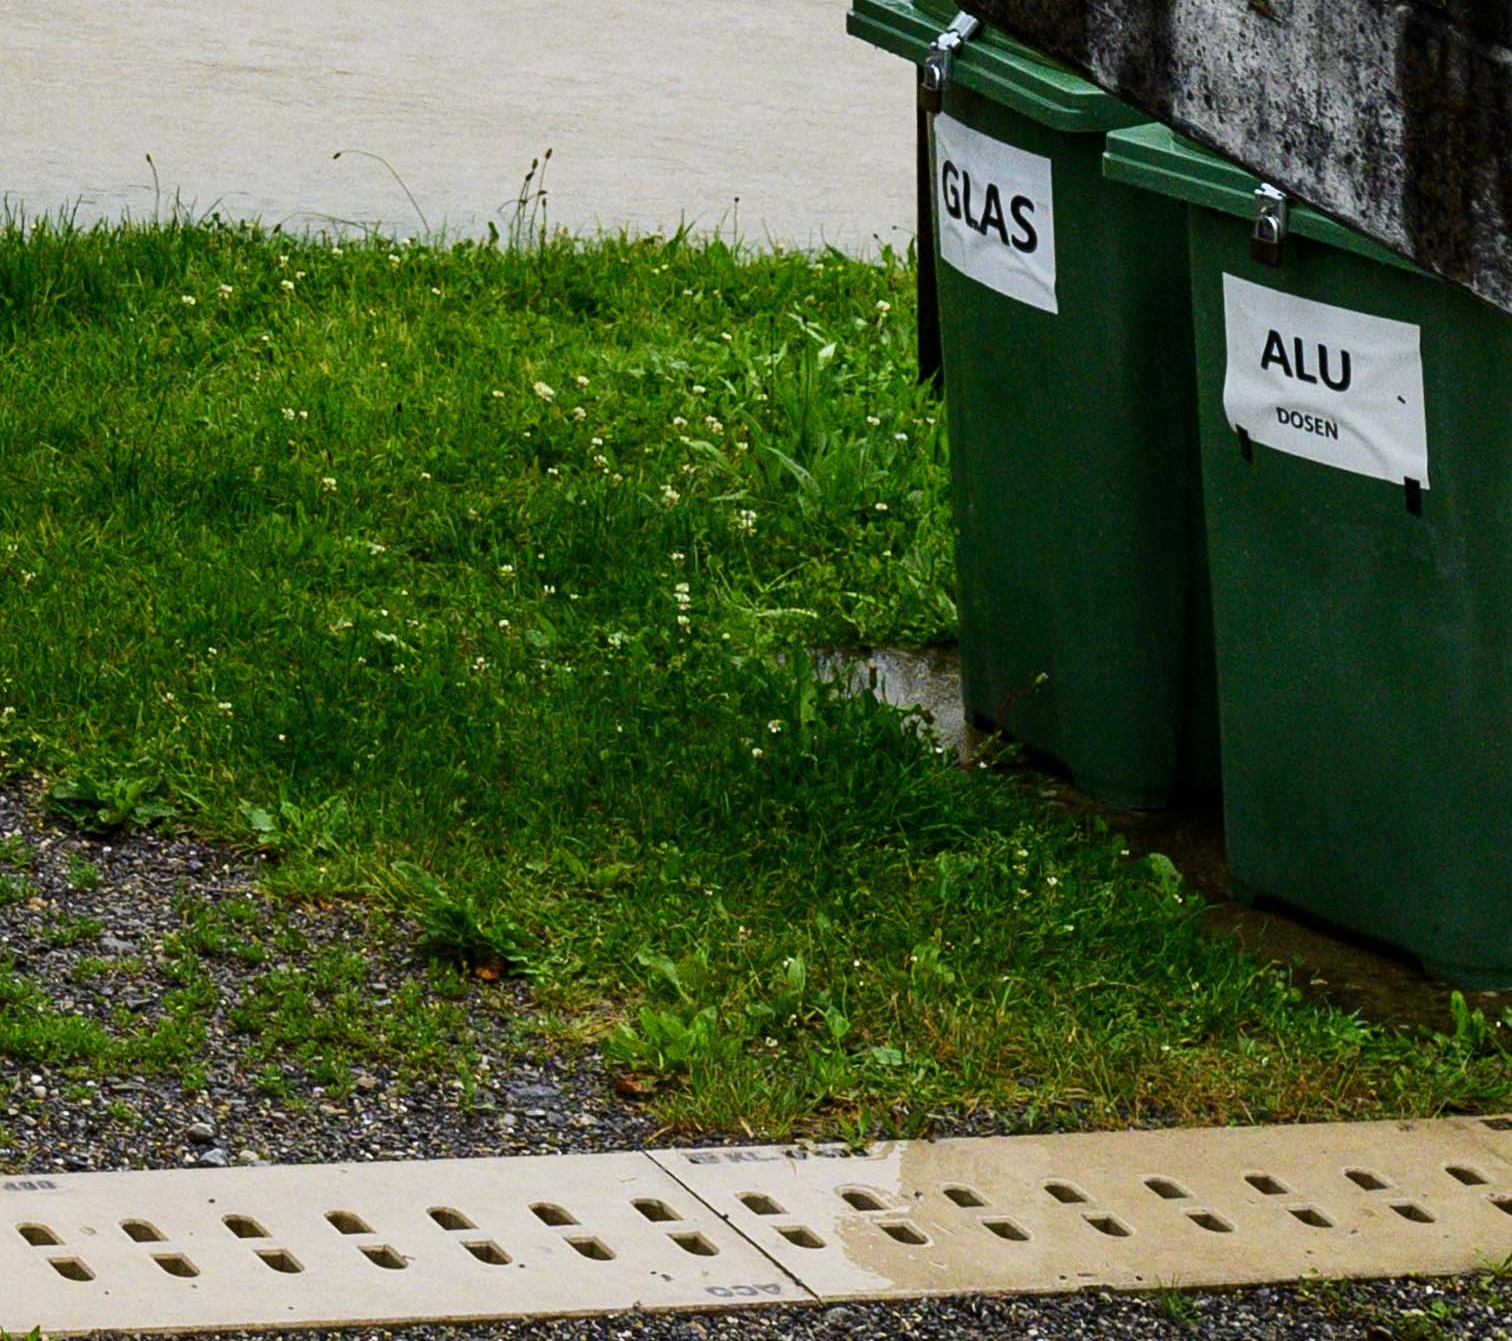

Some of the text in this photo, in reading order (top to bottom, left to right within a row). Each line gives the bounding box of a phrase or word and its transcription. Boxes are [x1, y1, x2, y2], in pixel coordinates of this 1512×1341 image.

[941, 161, 1039, 255] GLAS
[1259, 329, 1352, 393] ALU
[1276, 406, 1339, 441] DOSEN
